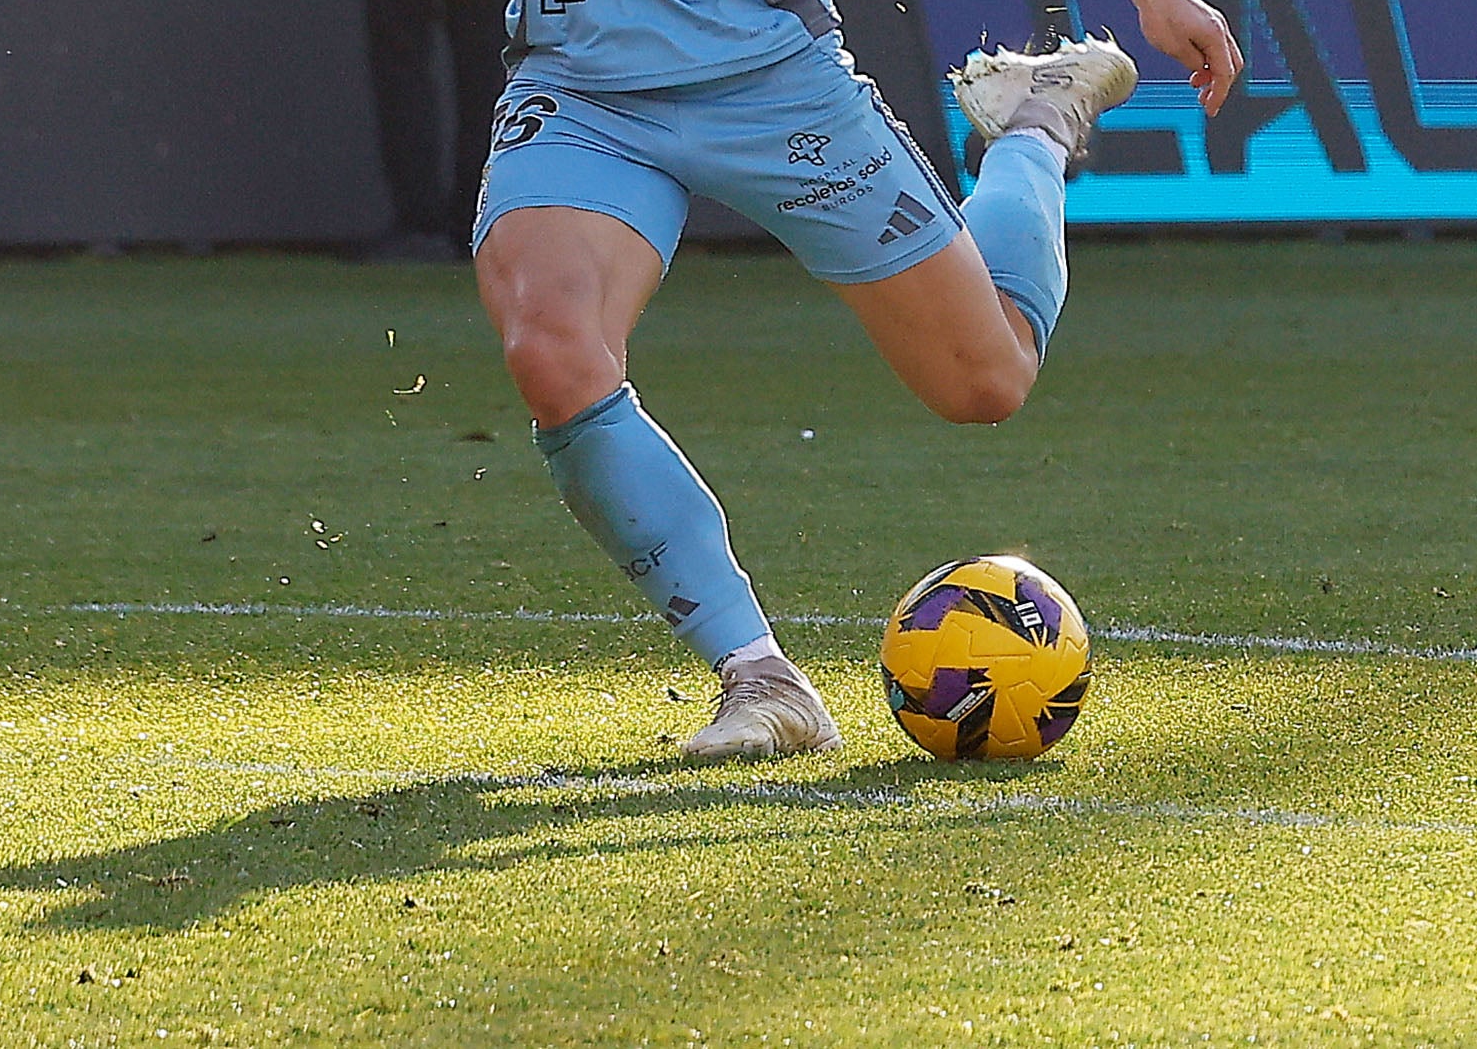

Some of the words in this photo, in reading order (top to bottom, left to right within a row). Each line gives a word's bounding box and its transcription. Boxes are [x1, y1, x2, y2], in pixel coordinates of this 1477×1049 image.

[776, 176, 856, 213] recoletas
[858, 145, 893, 180] salud
[821, 183, 874, 211] BURGOS
